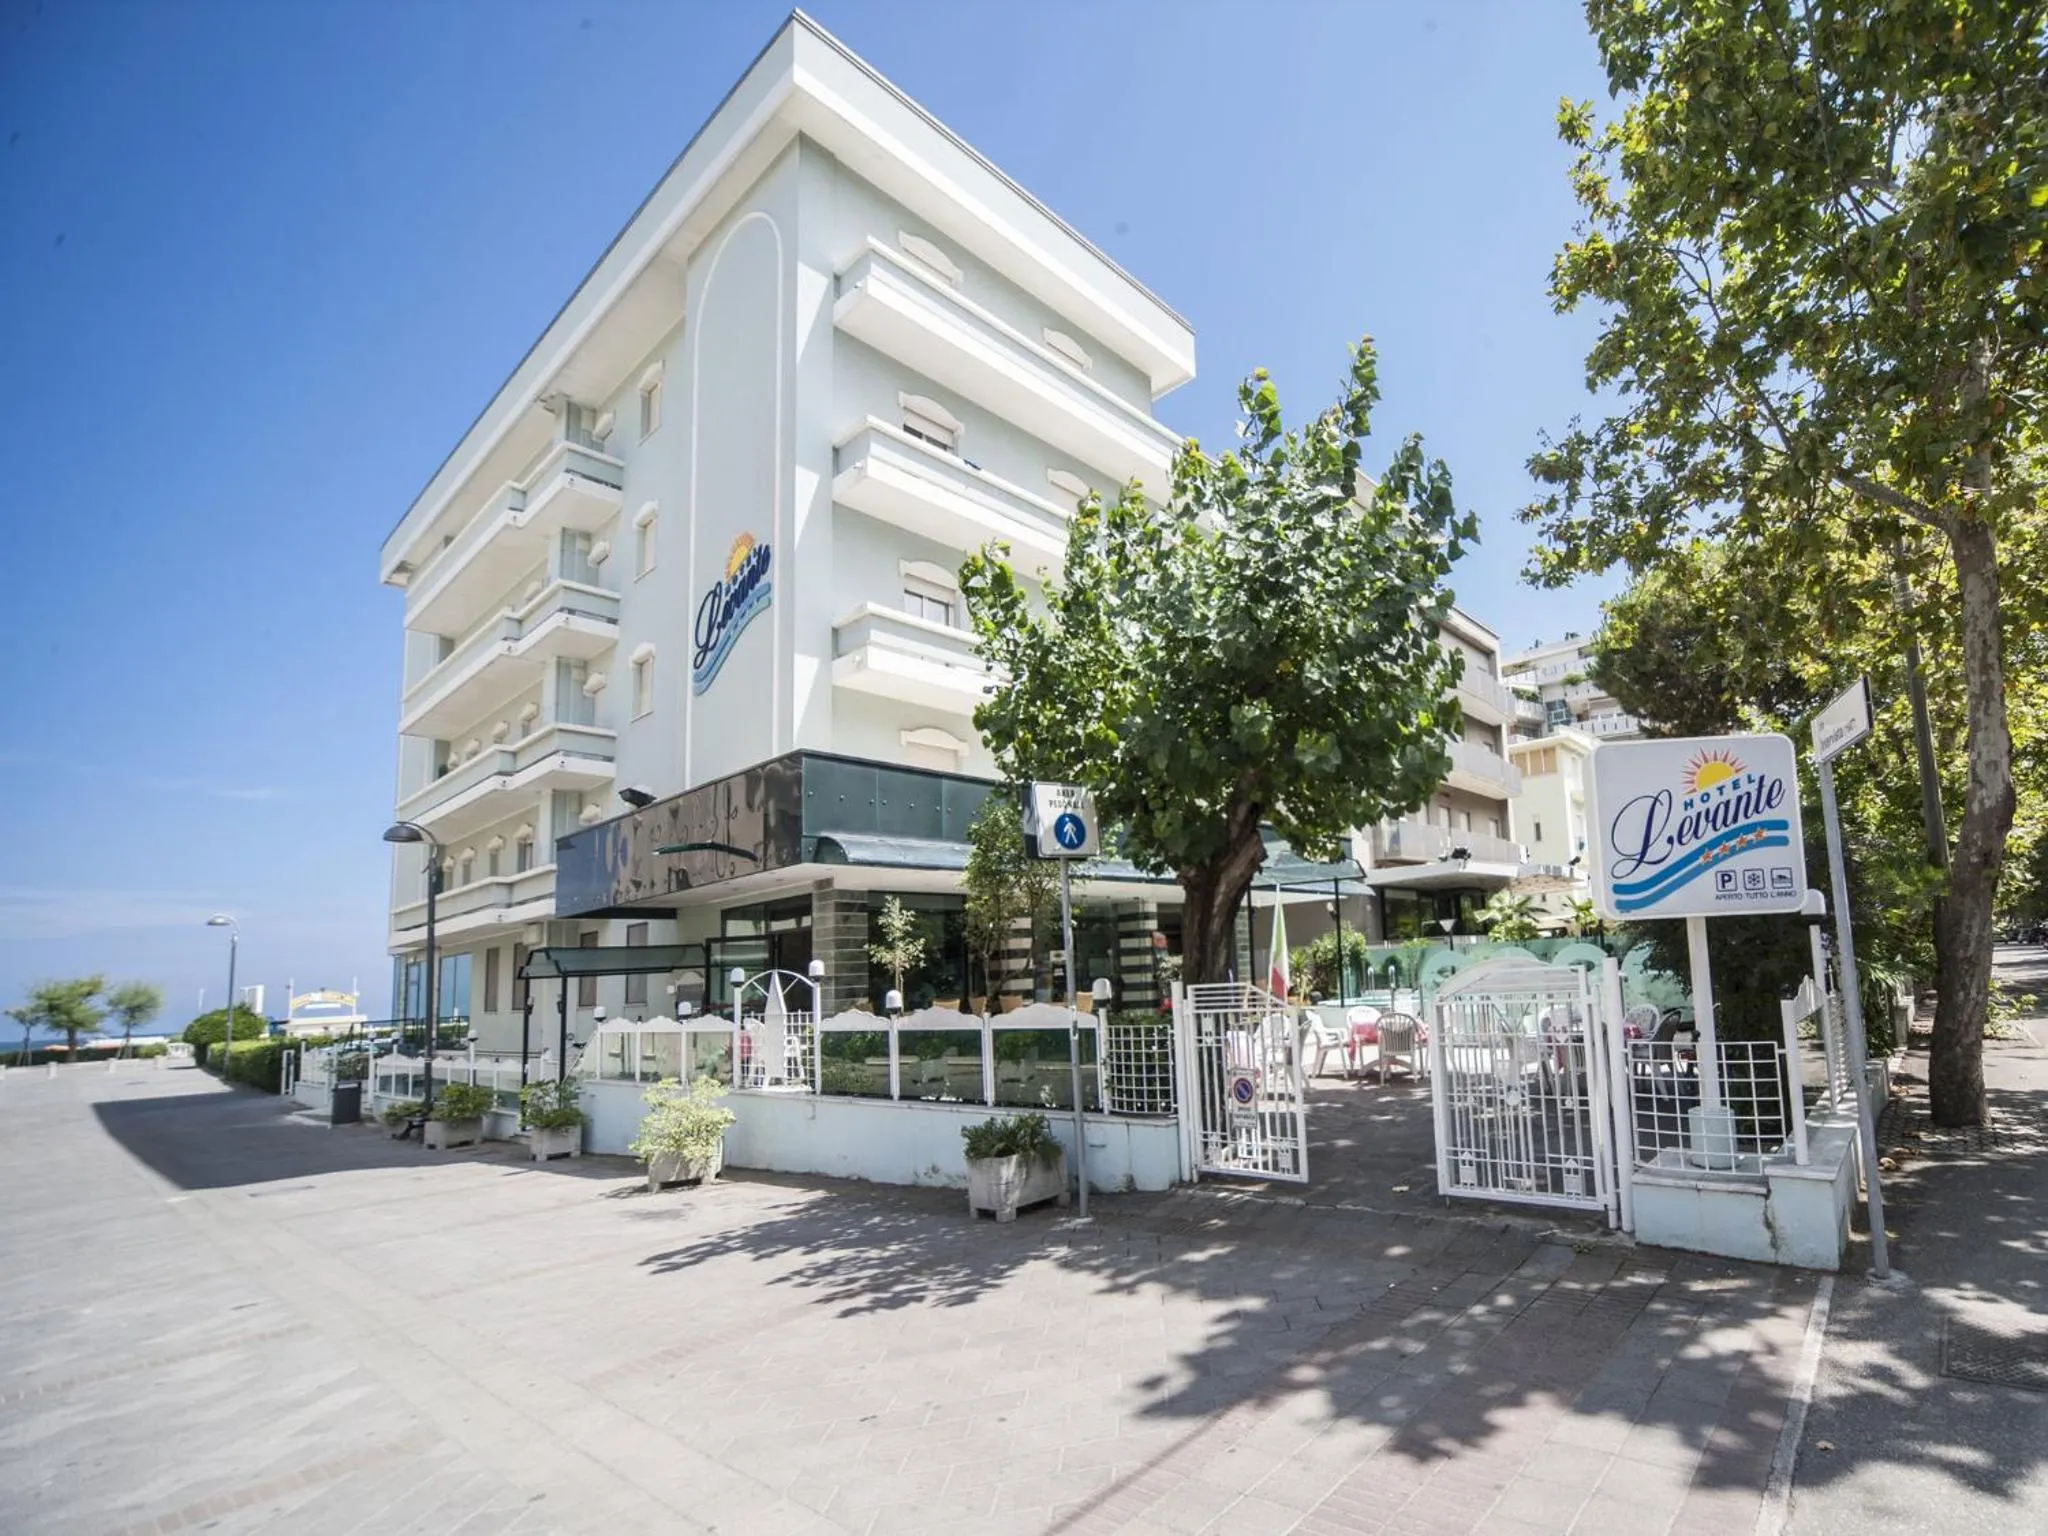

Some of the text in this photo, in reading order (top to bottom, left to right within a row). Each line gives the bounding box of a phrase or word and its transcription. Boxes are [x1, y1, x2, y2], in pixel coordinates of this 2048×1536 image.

[1684, 774, 1756, 811] HOTEL
[1611, 774, 1786, 879] Levante
[1715, 892, 1743, 900] APERTO
[1744, 891, 1769, 900] TUTTO
